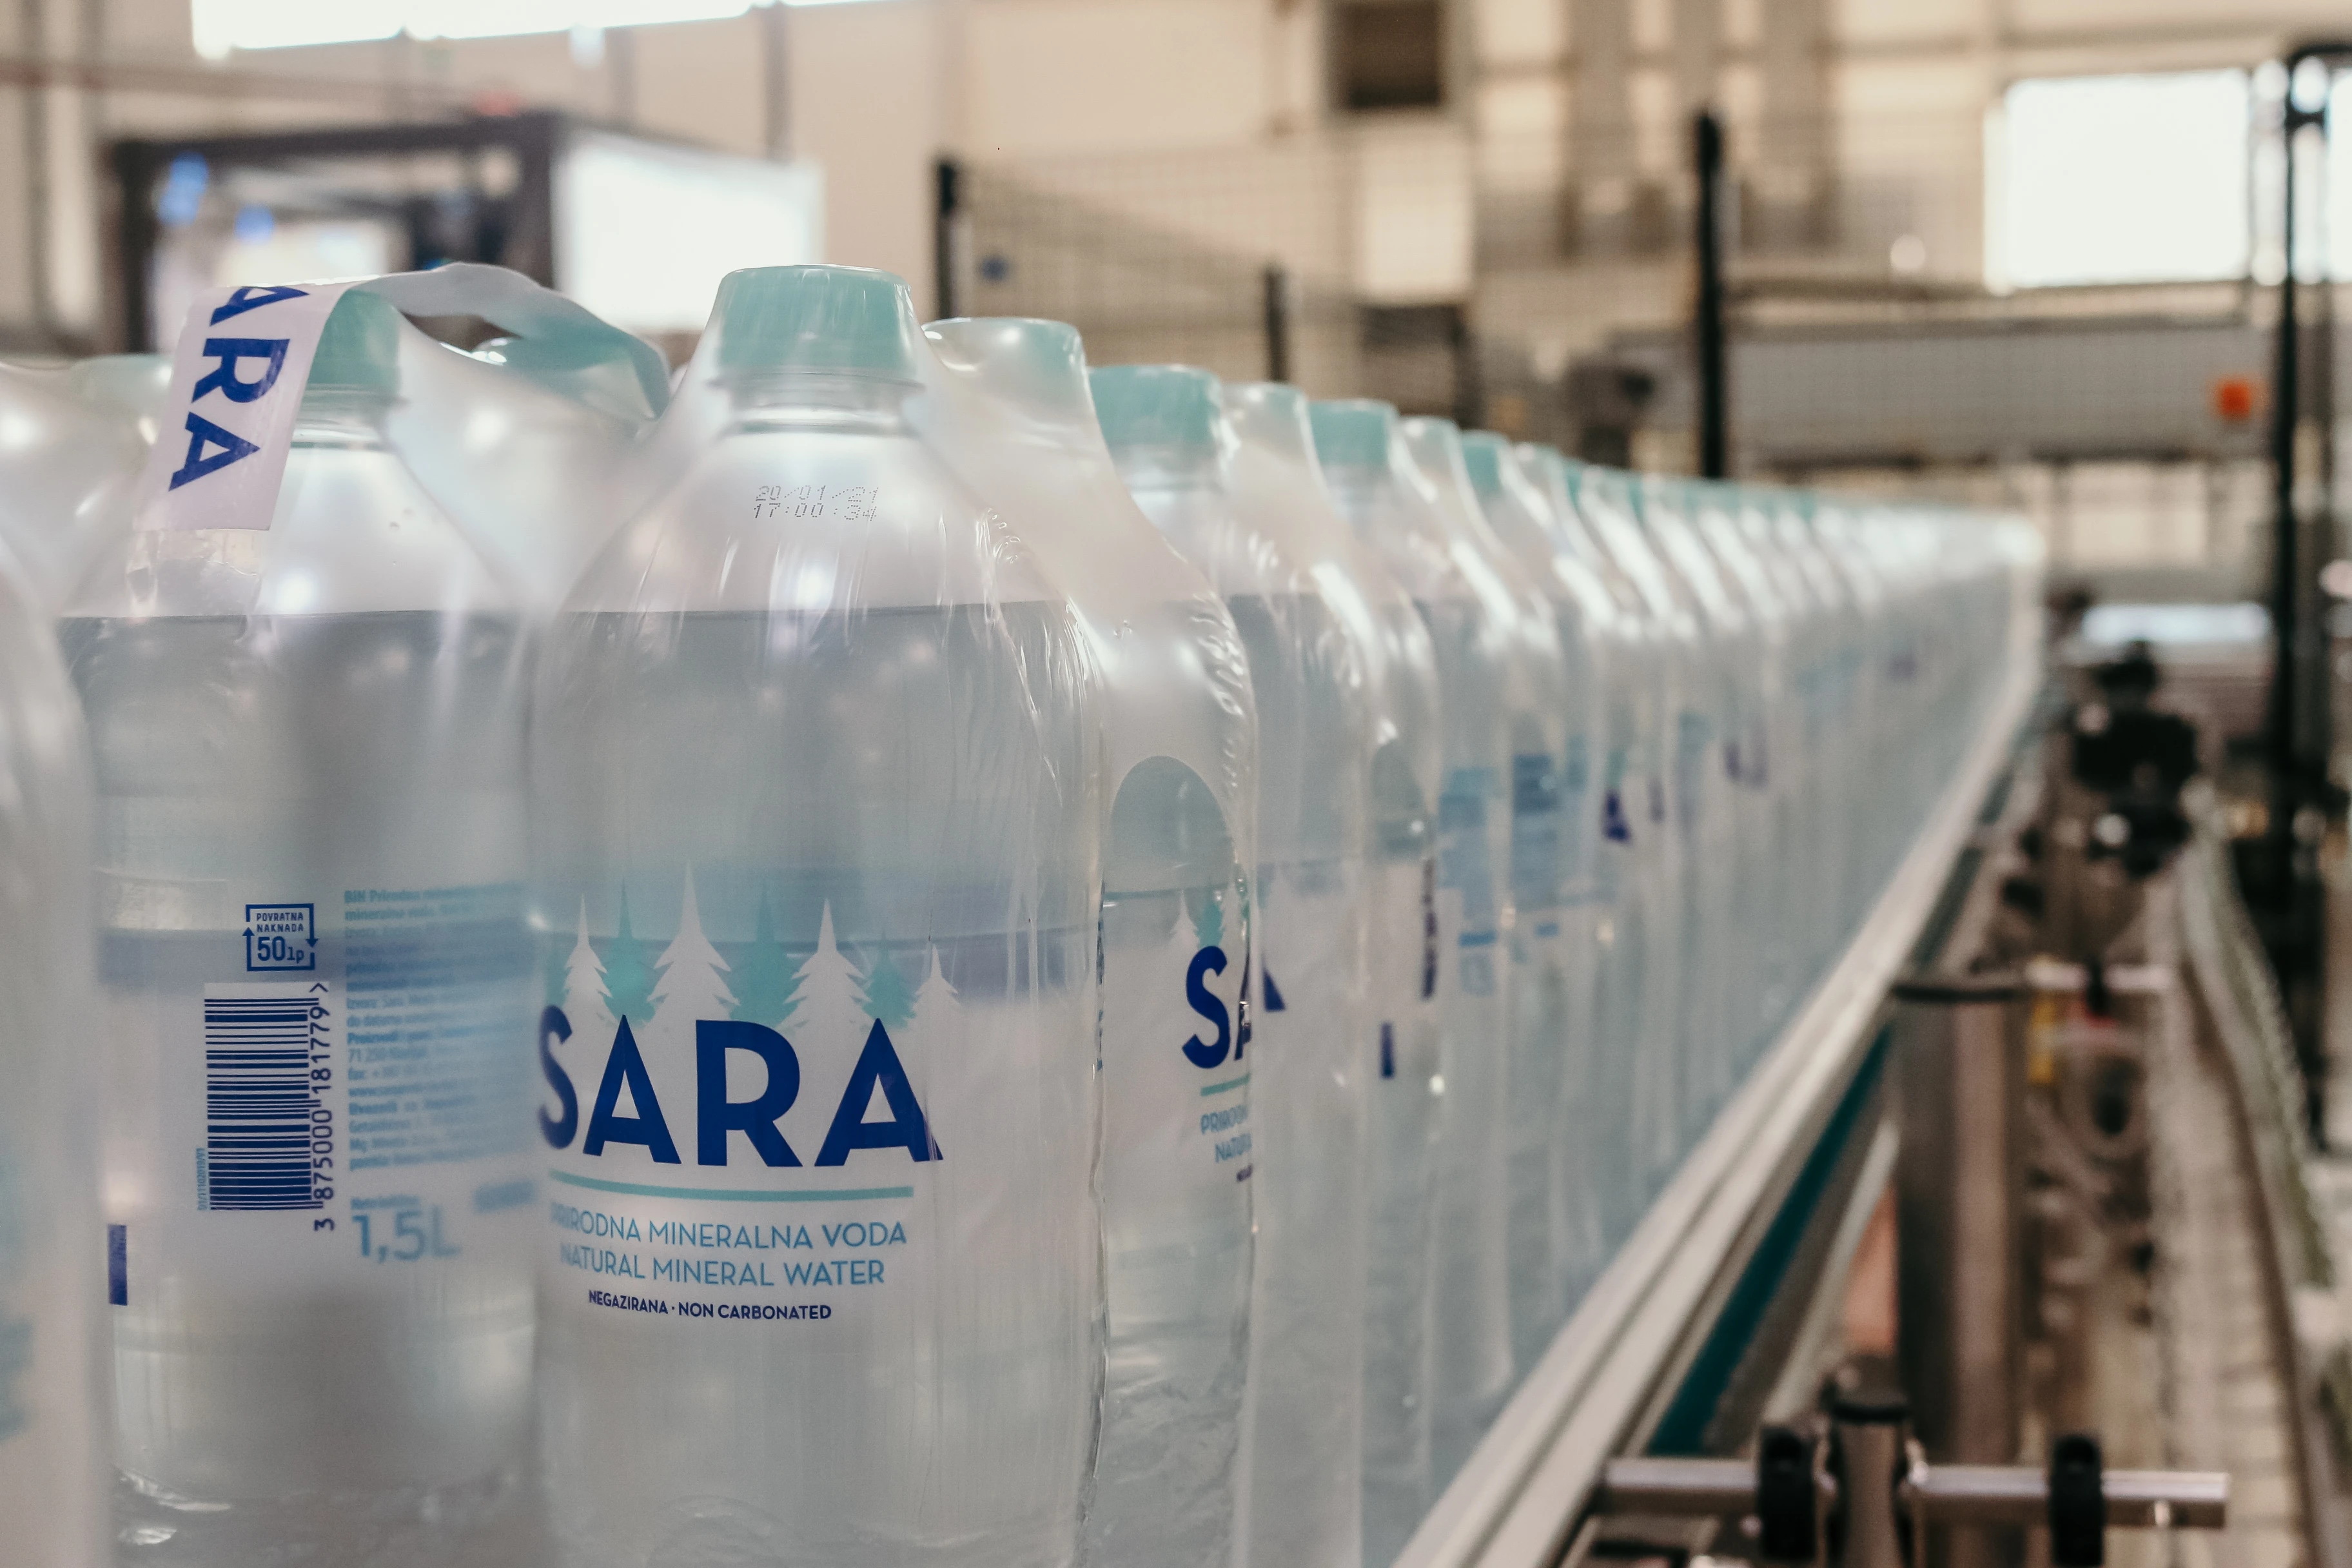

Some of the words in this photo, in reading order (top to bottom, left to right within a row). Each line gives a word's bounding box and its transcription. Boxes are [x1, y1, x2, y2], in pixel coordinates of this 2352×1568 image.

[756, 485, 879, 504] 20/01/21
[753, 502, 877, 522] 17:00:34
[256, 912, 304, 921] POVRATNA
[257, 923, 304, 933] NAKNADA
[309, 1006, 331, 1095] 181779
[538, 1004, 943, 1167] SARA
[311, 1109, 335, 1200] 875000
[649, 1220, 813, 1250] MINERALNA
[821, 1220, 907, 1248] VODA
[560, 1242, 645, 1280] NATURAL
[653, 1257, 774, 1286] MINERAL
[783, 1259, 885, 1286] WATER
[589, 1289, 669, 1315] NEGAZIRANA
[678, 1301, 714, 1318] NON
[718, 1304, 832, 1320] CARBONATED
